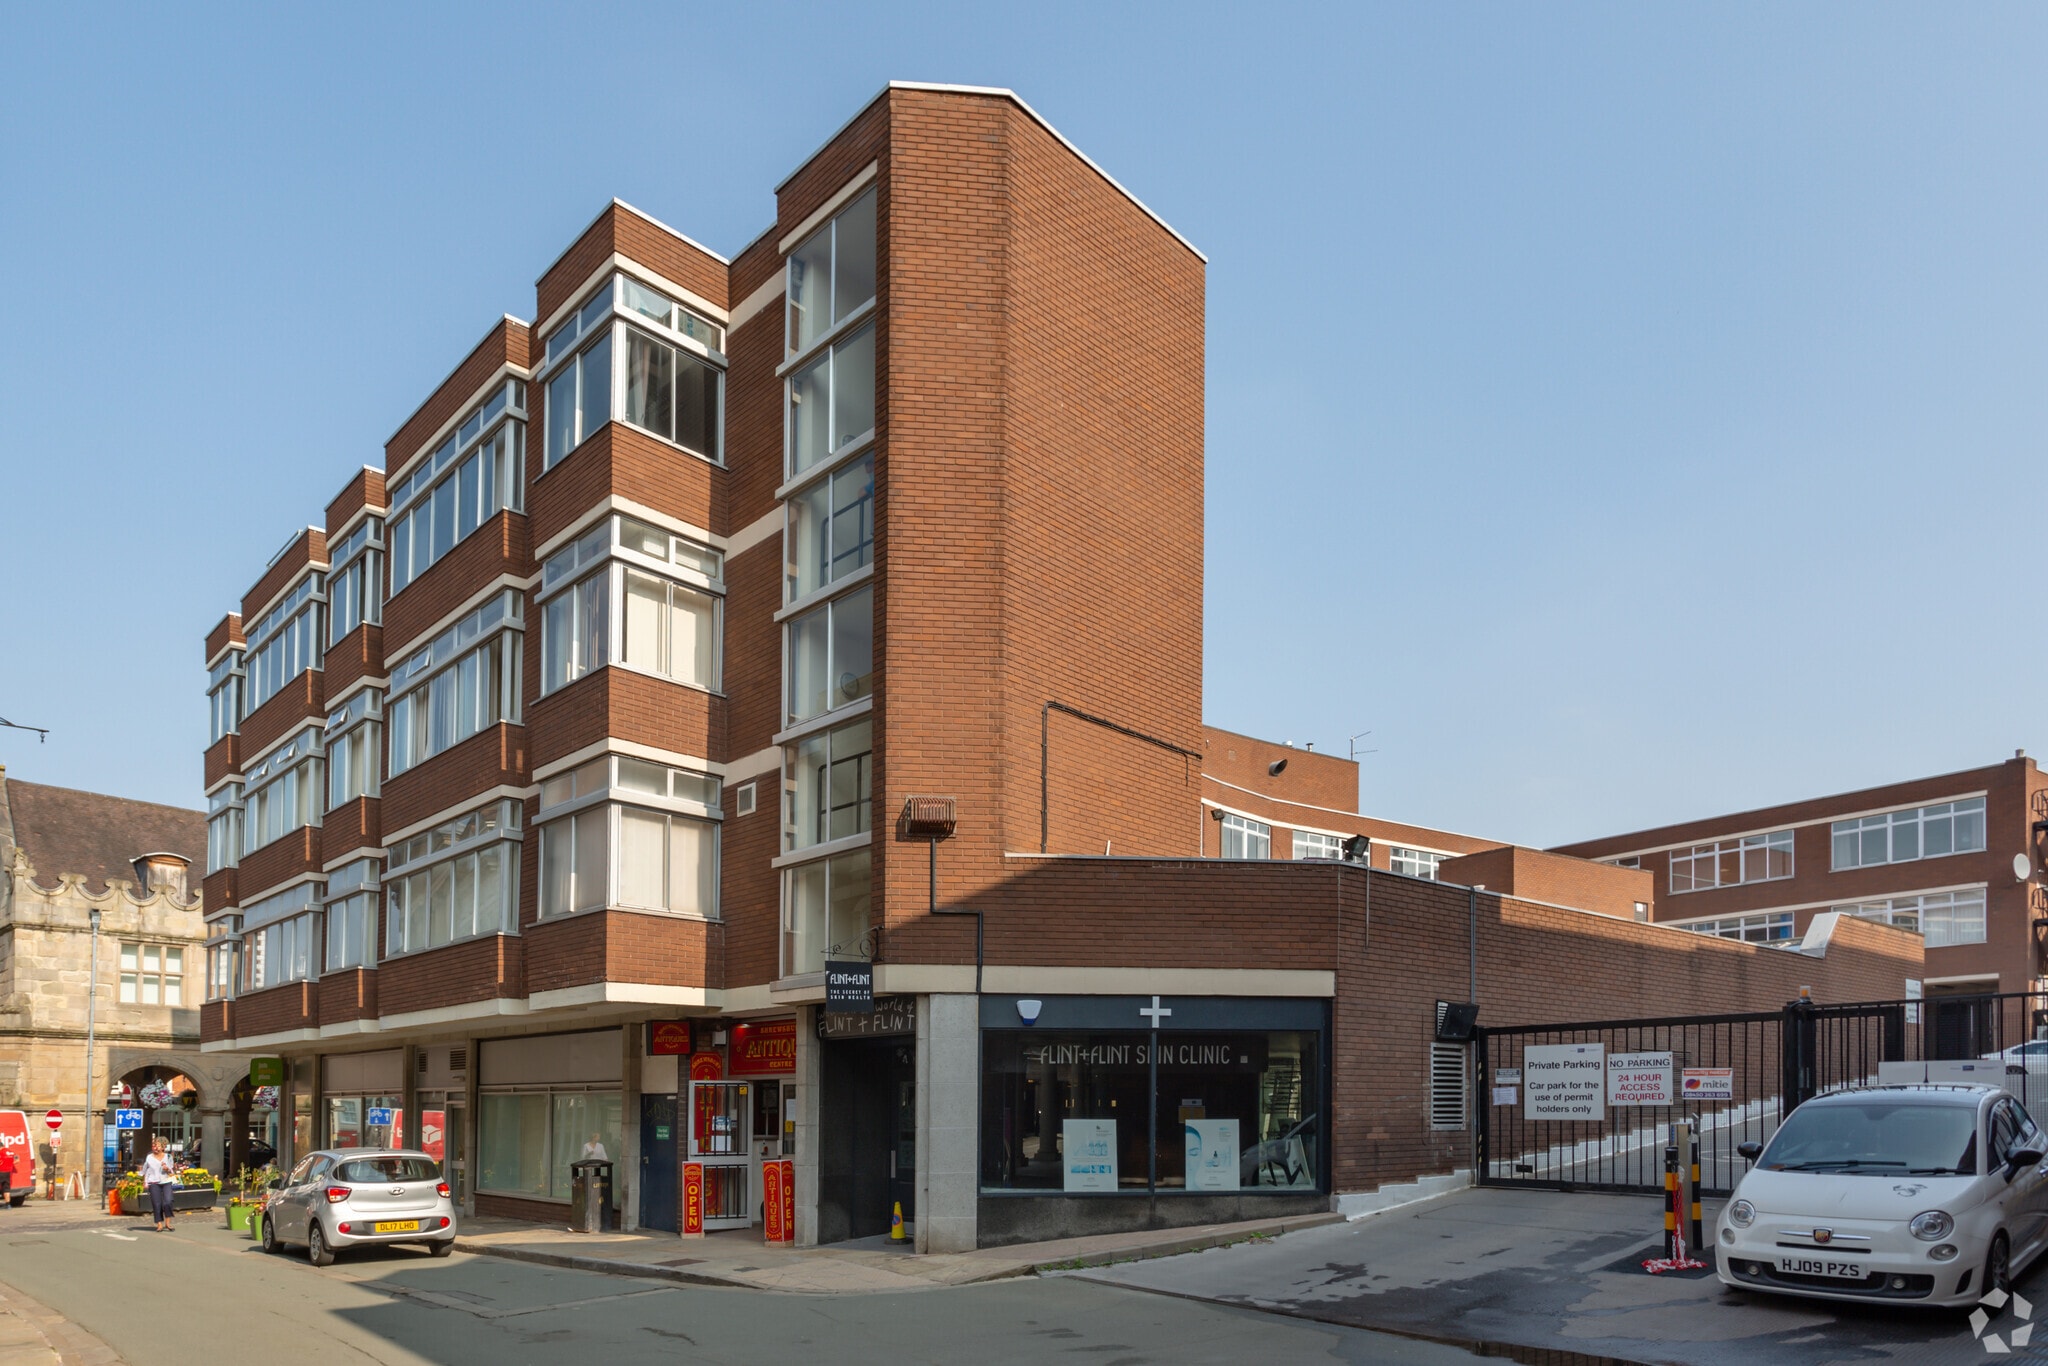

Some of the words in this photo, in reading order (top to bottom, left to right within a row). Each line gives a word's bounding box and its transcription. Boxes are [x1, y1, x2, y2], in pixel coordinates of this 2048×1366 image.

[830, 974, 870, 985] FLINT+FLINT
[818, 1015, 853, 1037] FLINT
[873, 1014, 914, 1032] FLINT
[1040, 1045, 1130, 1064] FLINT+FLINT
[1179, 1045, 1230, 1064] CLINIC
[1528, 1061, 1560, 1070] Private
[1563, 1060, 1600, 1070] Parking
[1609, 1060, 1624, 1068] NO
[1627, 1058, 1670, 1068] PARKING
[1618, 1074, 1629, 1082] 24
[1633, 1073, 1662, 1081] HOUR
[1529, 1082, 1544, 1090] Car
[1547, 1082, 1567, 1091] park
[1584, 1081, 1599, 1089] the
[1620, 1083, 1660, 1091] ACCESS
[1702, 1080, 1729, 1089] mitie
[1553, 1093, 1562, 1101] of
[1564, 1093, 1593, 1102] permit
[1615, 1092, 1665, 1100] REQUIRED
[1536, 1105, 1570, 1113] holders
[1572, 1105, 1592, 1114] only
[687, 1185, 699, 1227] OPEN
[767, 1174, 777, 1229] ANTIQUES
[784, 1185, 793, 1231] OPEN
[380, 1223, 397, 1231] DL17
[1782, 1258, 1823, 1273] HJ09
[1827, 1262, 1860, 1277] PZS
